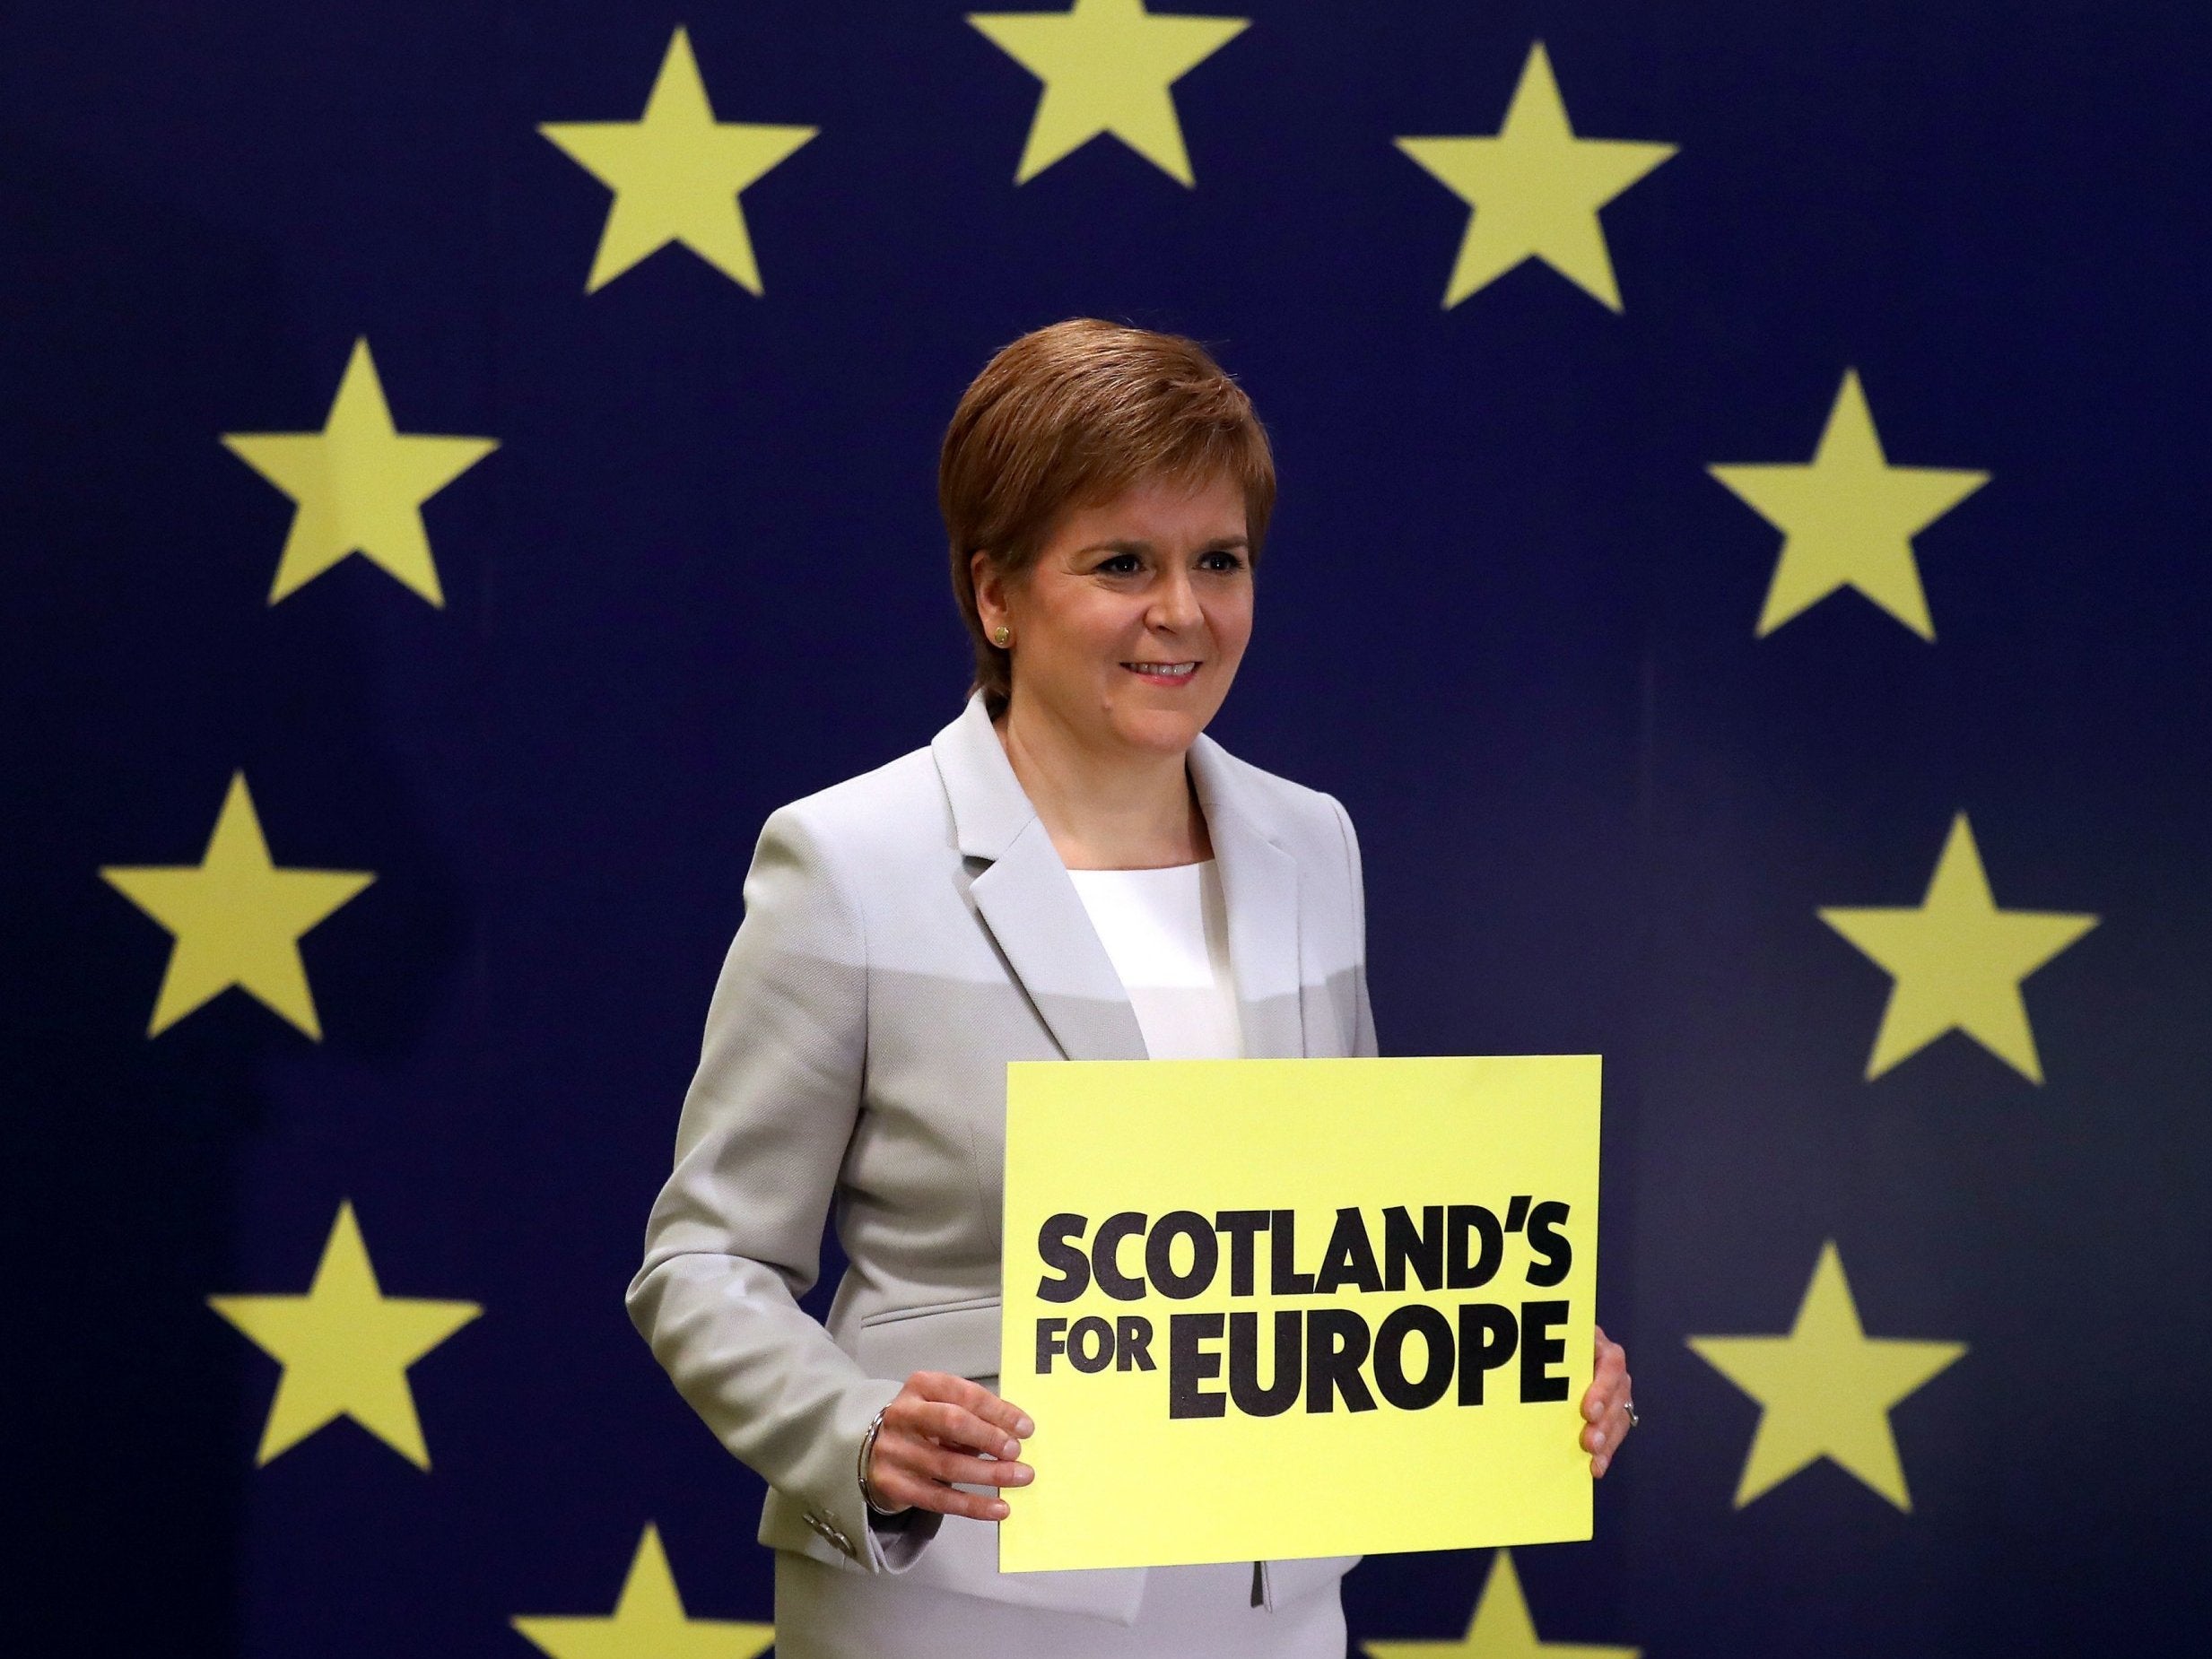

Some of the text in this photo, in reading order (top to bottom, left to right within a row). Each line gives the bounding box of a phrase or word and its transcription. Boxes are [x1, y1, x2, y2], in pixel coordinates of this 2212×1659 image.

[1036, 1195, 1572, 1304] SCOTLAND'S
[1035, 1300, 1570, 1420] FOR EUROPE
